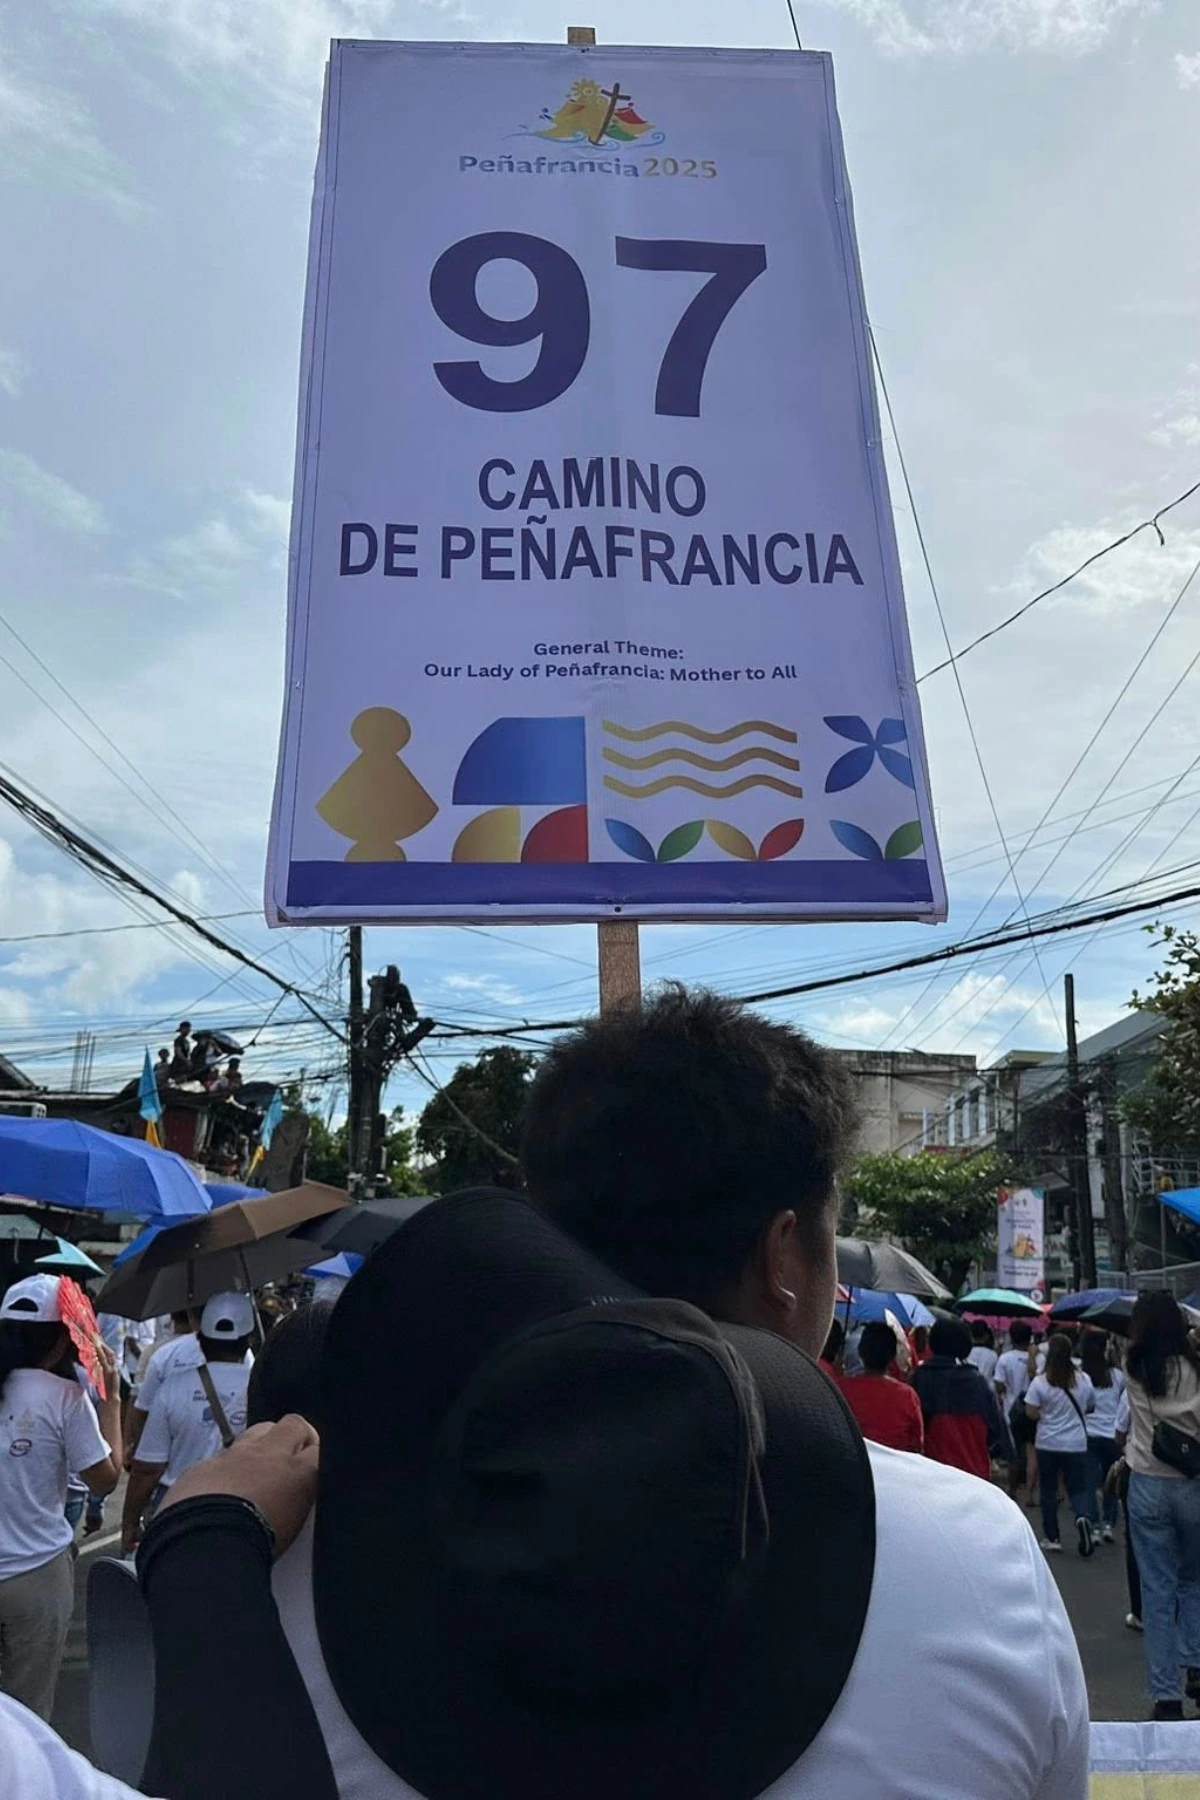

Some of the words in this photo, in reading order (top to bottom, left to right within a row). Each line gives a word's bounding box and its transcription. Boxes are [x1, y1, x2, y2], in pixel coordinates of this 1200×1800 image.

[459, 154, 640, 178] Peñafrancia
[643, 157, 718, 179] 2025
[429, 231, 768, 418] 97
[478, 456, 706, 518] CAMINO
[339, 522, 419, 578] DE
[440, 514, 865, 586] PEÑAFRANCIA
[424, 663, 462, 677] Our
[467, 663, 514, 681] Lady
[519, 663, 540, 678] of
[545, 661, 665, 681] Peñafrancia:
[670, 667, 741, 682] Mother
[745, 667, 766, 681] to
[771, 665, 798, 680] All
[533, 640, 610, 656] General
[614, 640, 684, 660] Theme:
